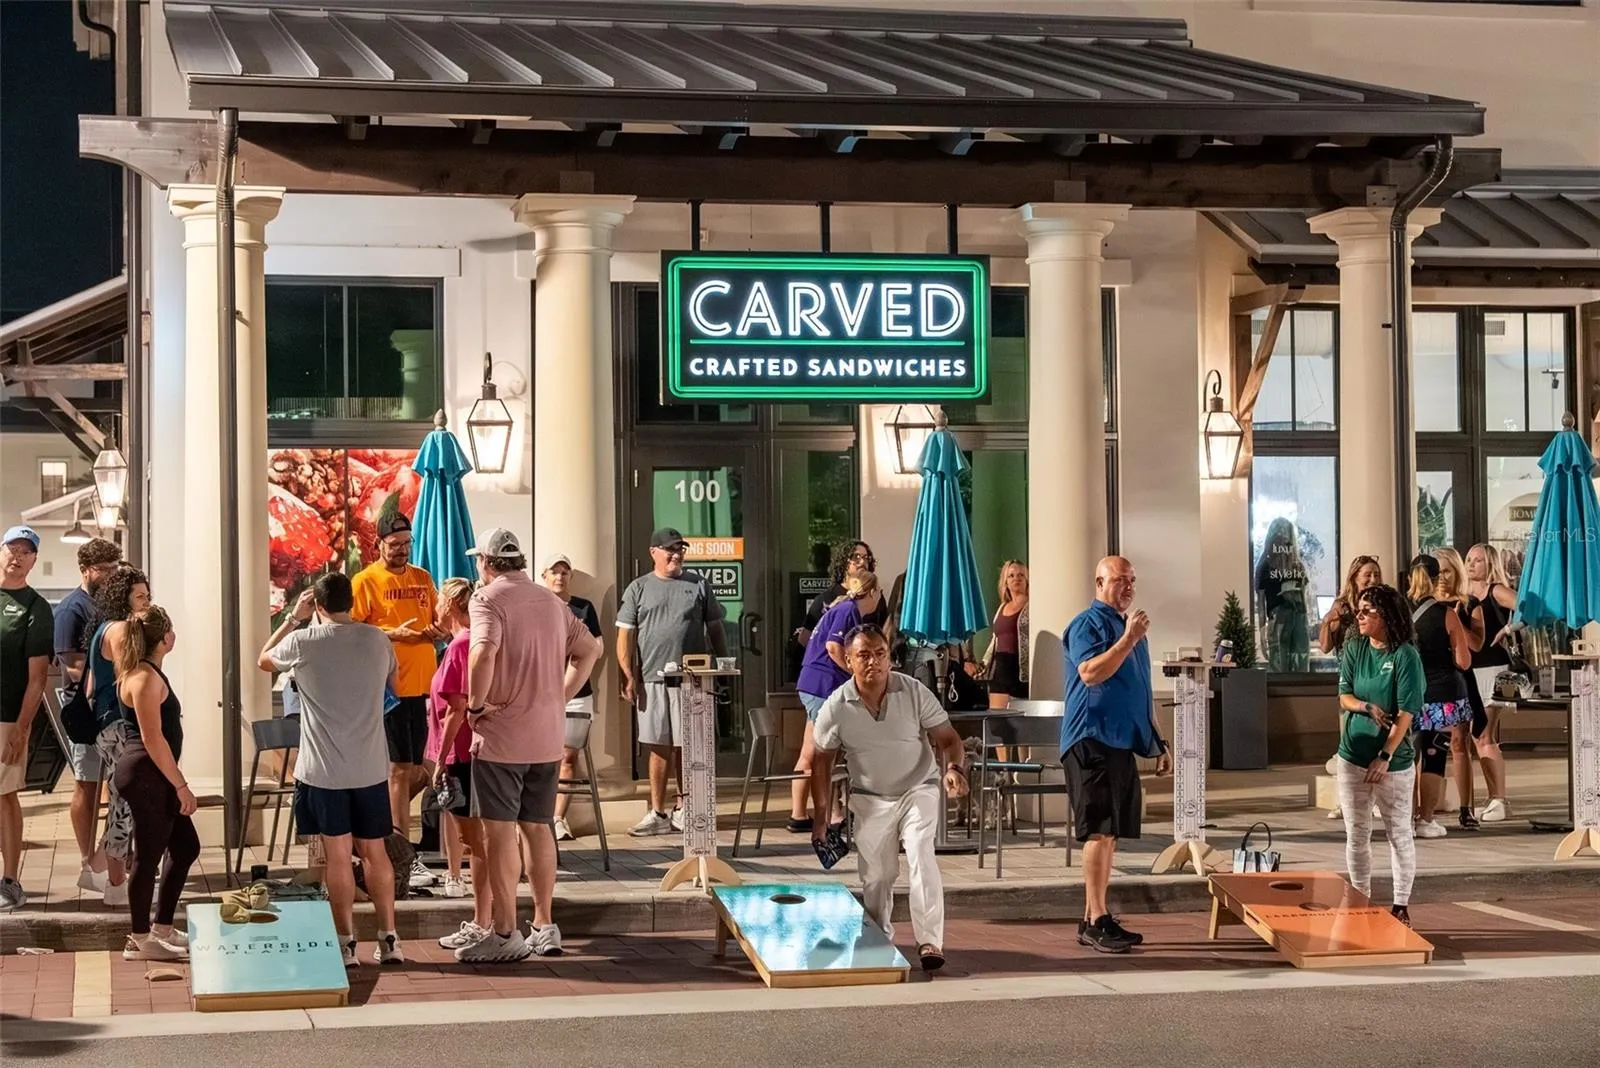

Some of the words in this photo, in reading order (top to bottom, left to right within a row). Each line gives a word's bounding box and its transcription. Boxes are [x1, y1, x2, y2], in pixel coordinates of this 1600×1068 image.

[689, 280, 966, 337] CARVED
[689, 358, 798, 376] CRAFTED
[808, 359, 967, 377] SANDWICHES
[674, 479, 721, 503] 100
[706, 541, 735, 555] SOON
[801, 580, 832, 588] CARVED
[196, 940, 335, 951] WATERSIDE
